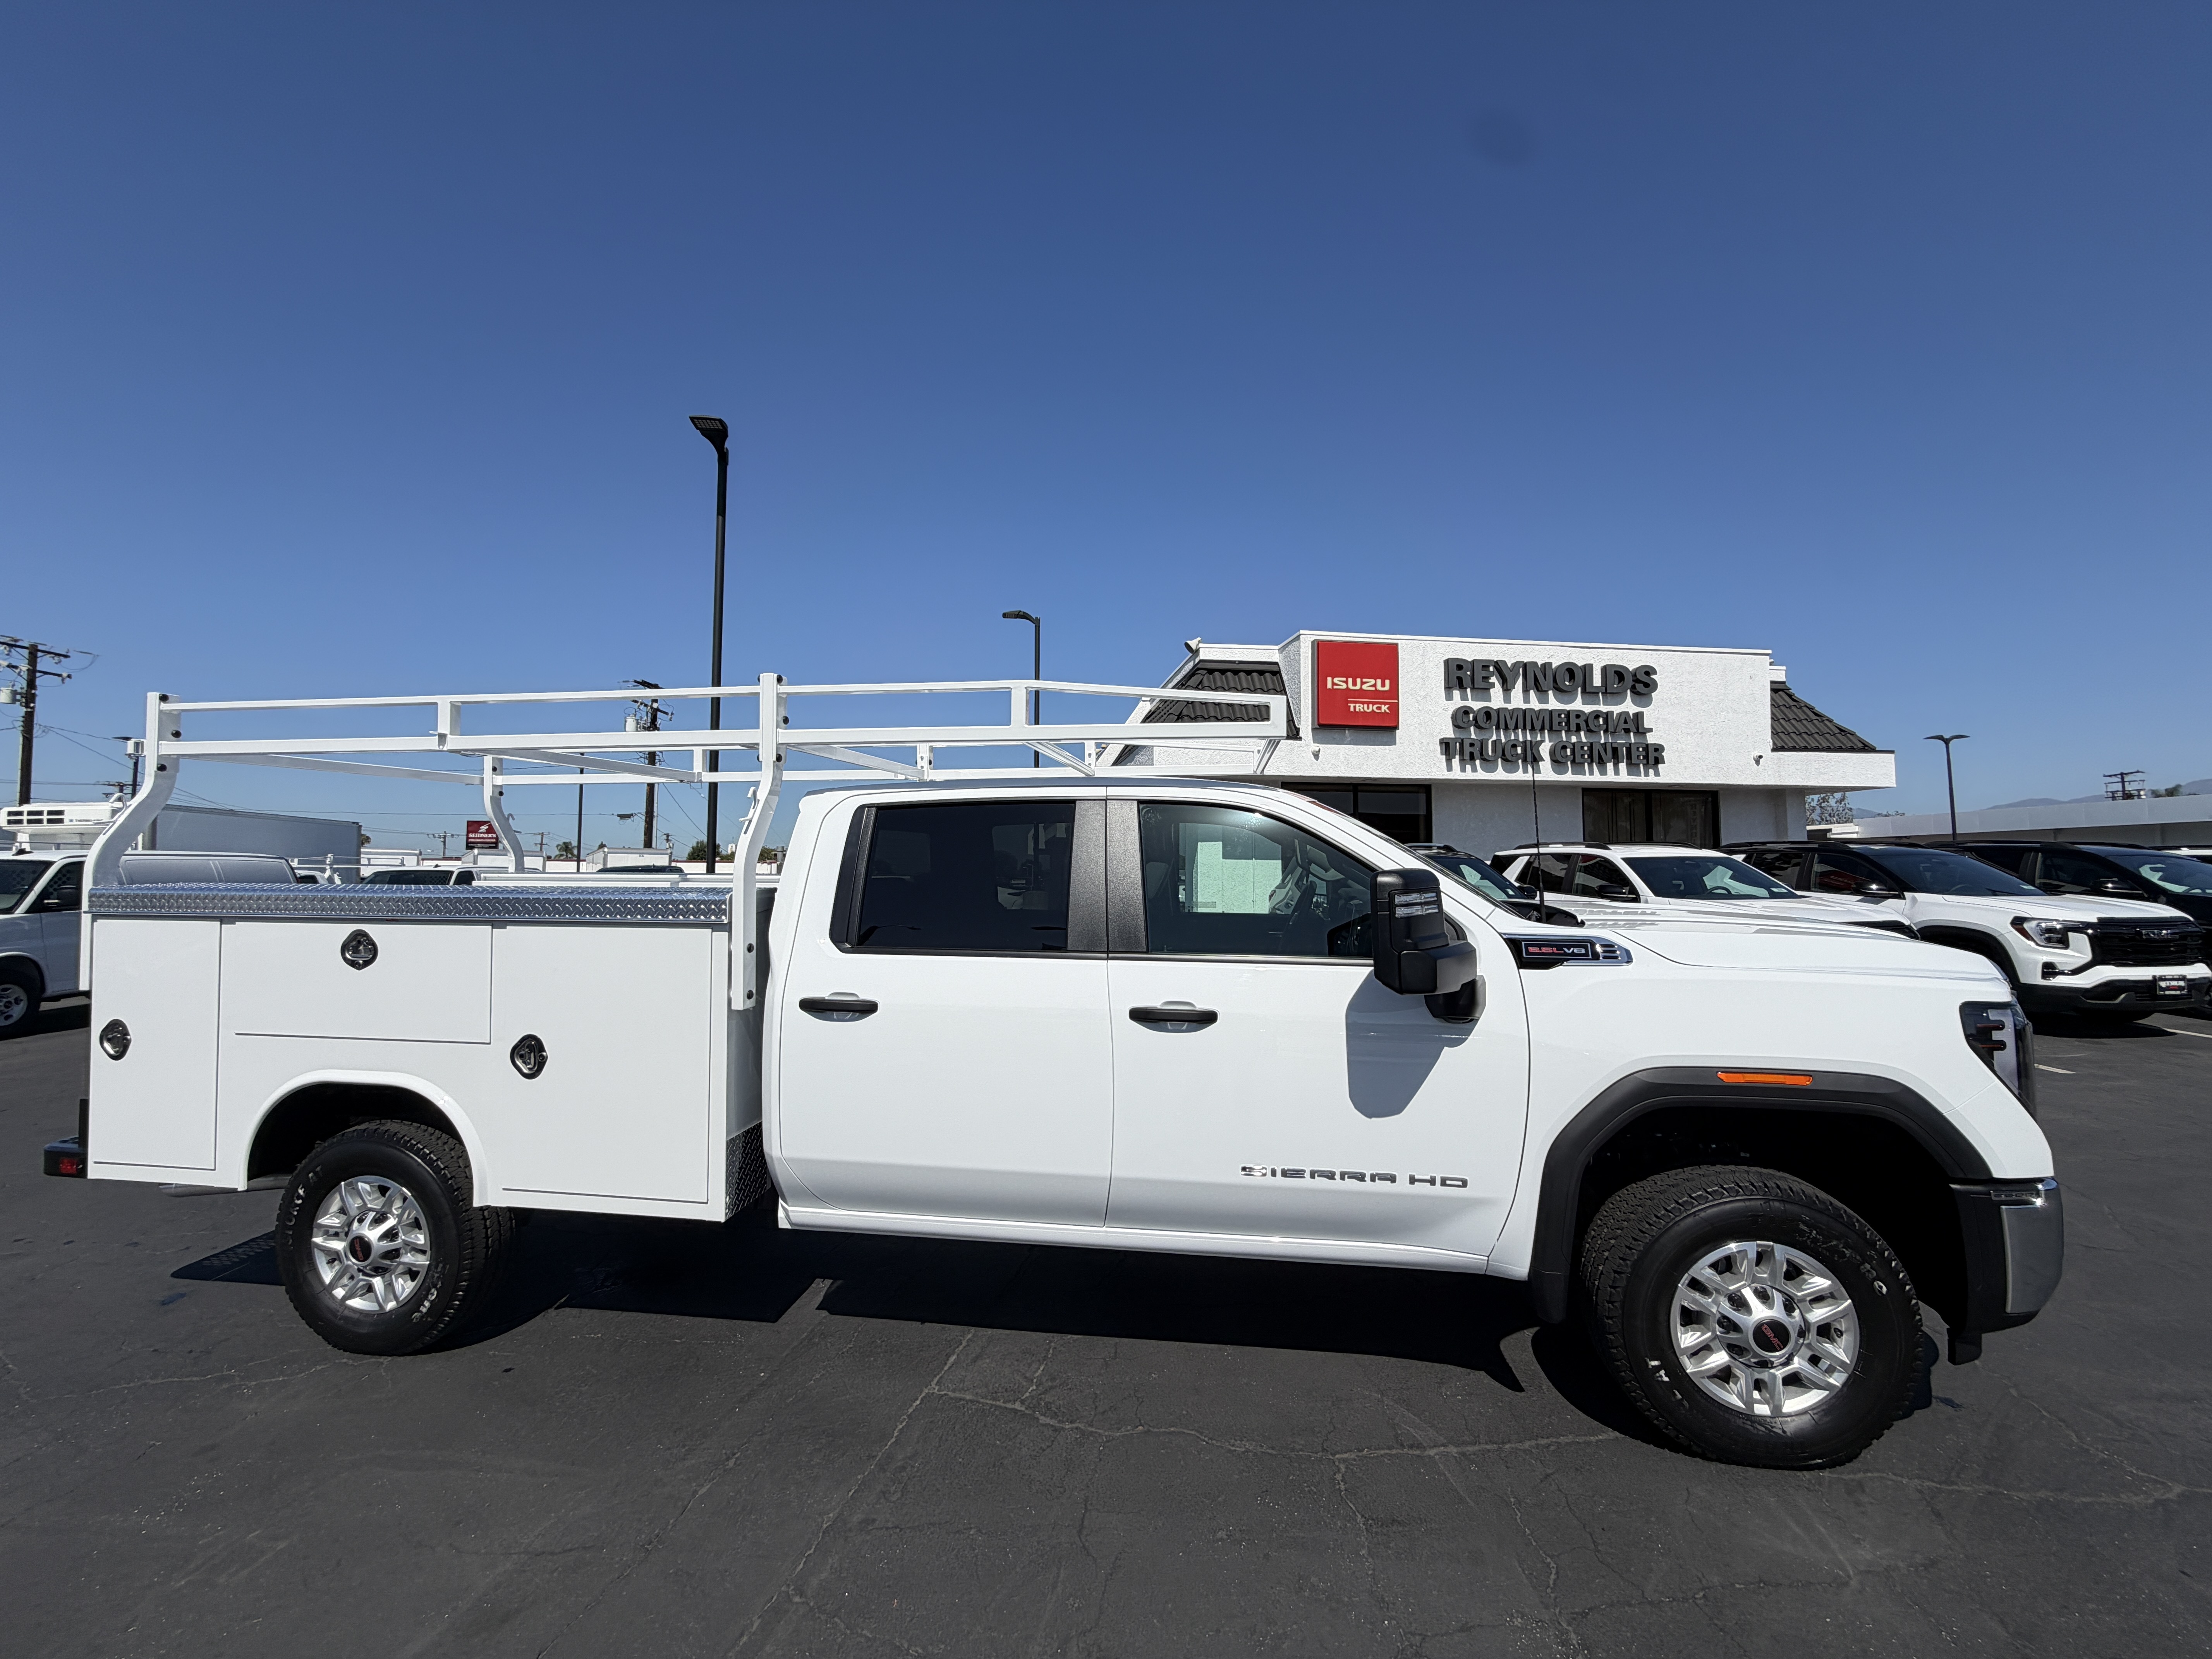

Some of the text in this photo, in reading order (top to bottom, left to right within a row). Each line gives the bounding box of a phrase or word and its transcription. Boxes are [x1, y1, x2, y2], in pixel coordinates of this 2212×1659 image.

[1327, 677, 1390, 692] ISUZU
[1444, 658, 1658, 696] REYNOLDS
[1348, 702, 1390, 713] TRUCK
[1452, 705, 1653, 734] COMMERCIAL
[1439, 737, 1666, 765] TRUCK CENTER
[1240, 1164, 1468, 1188] SIERRA HD
[1761, 1324, 1784, 1351] GMC
